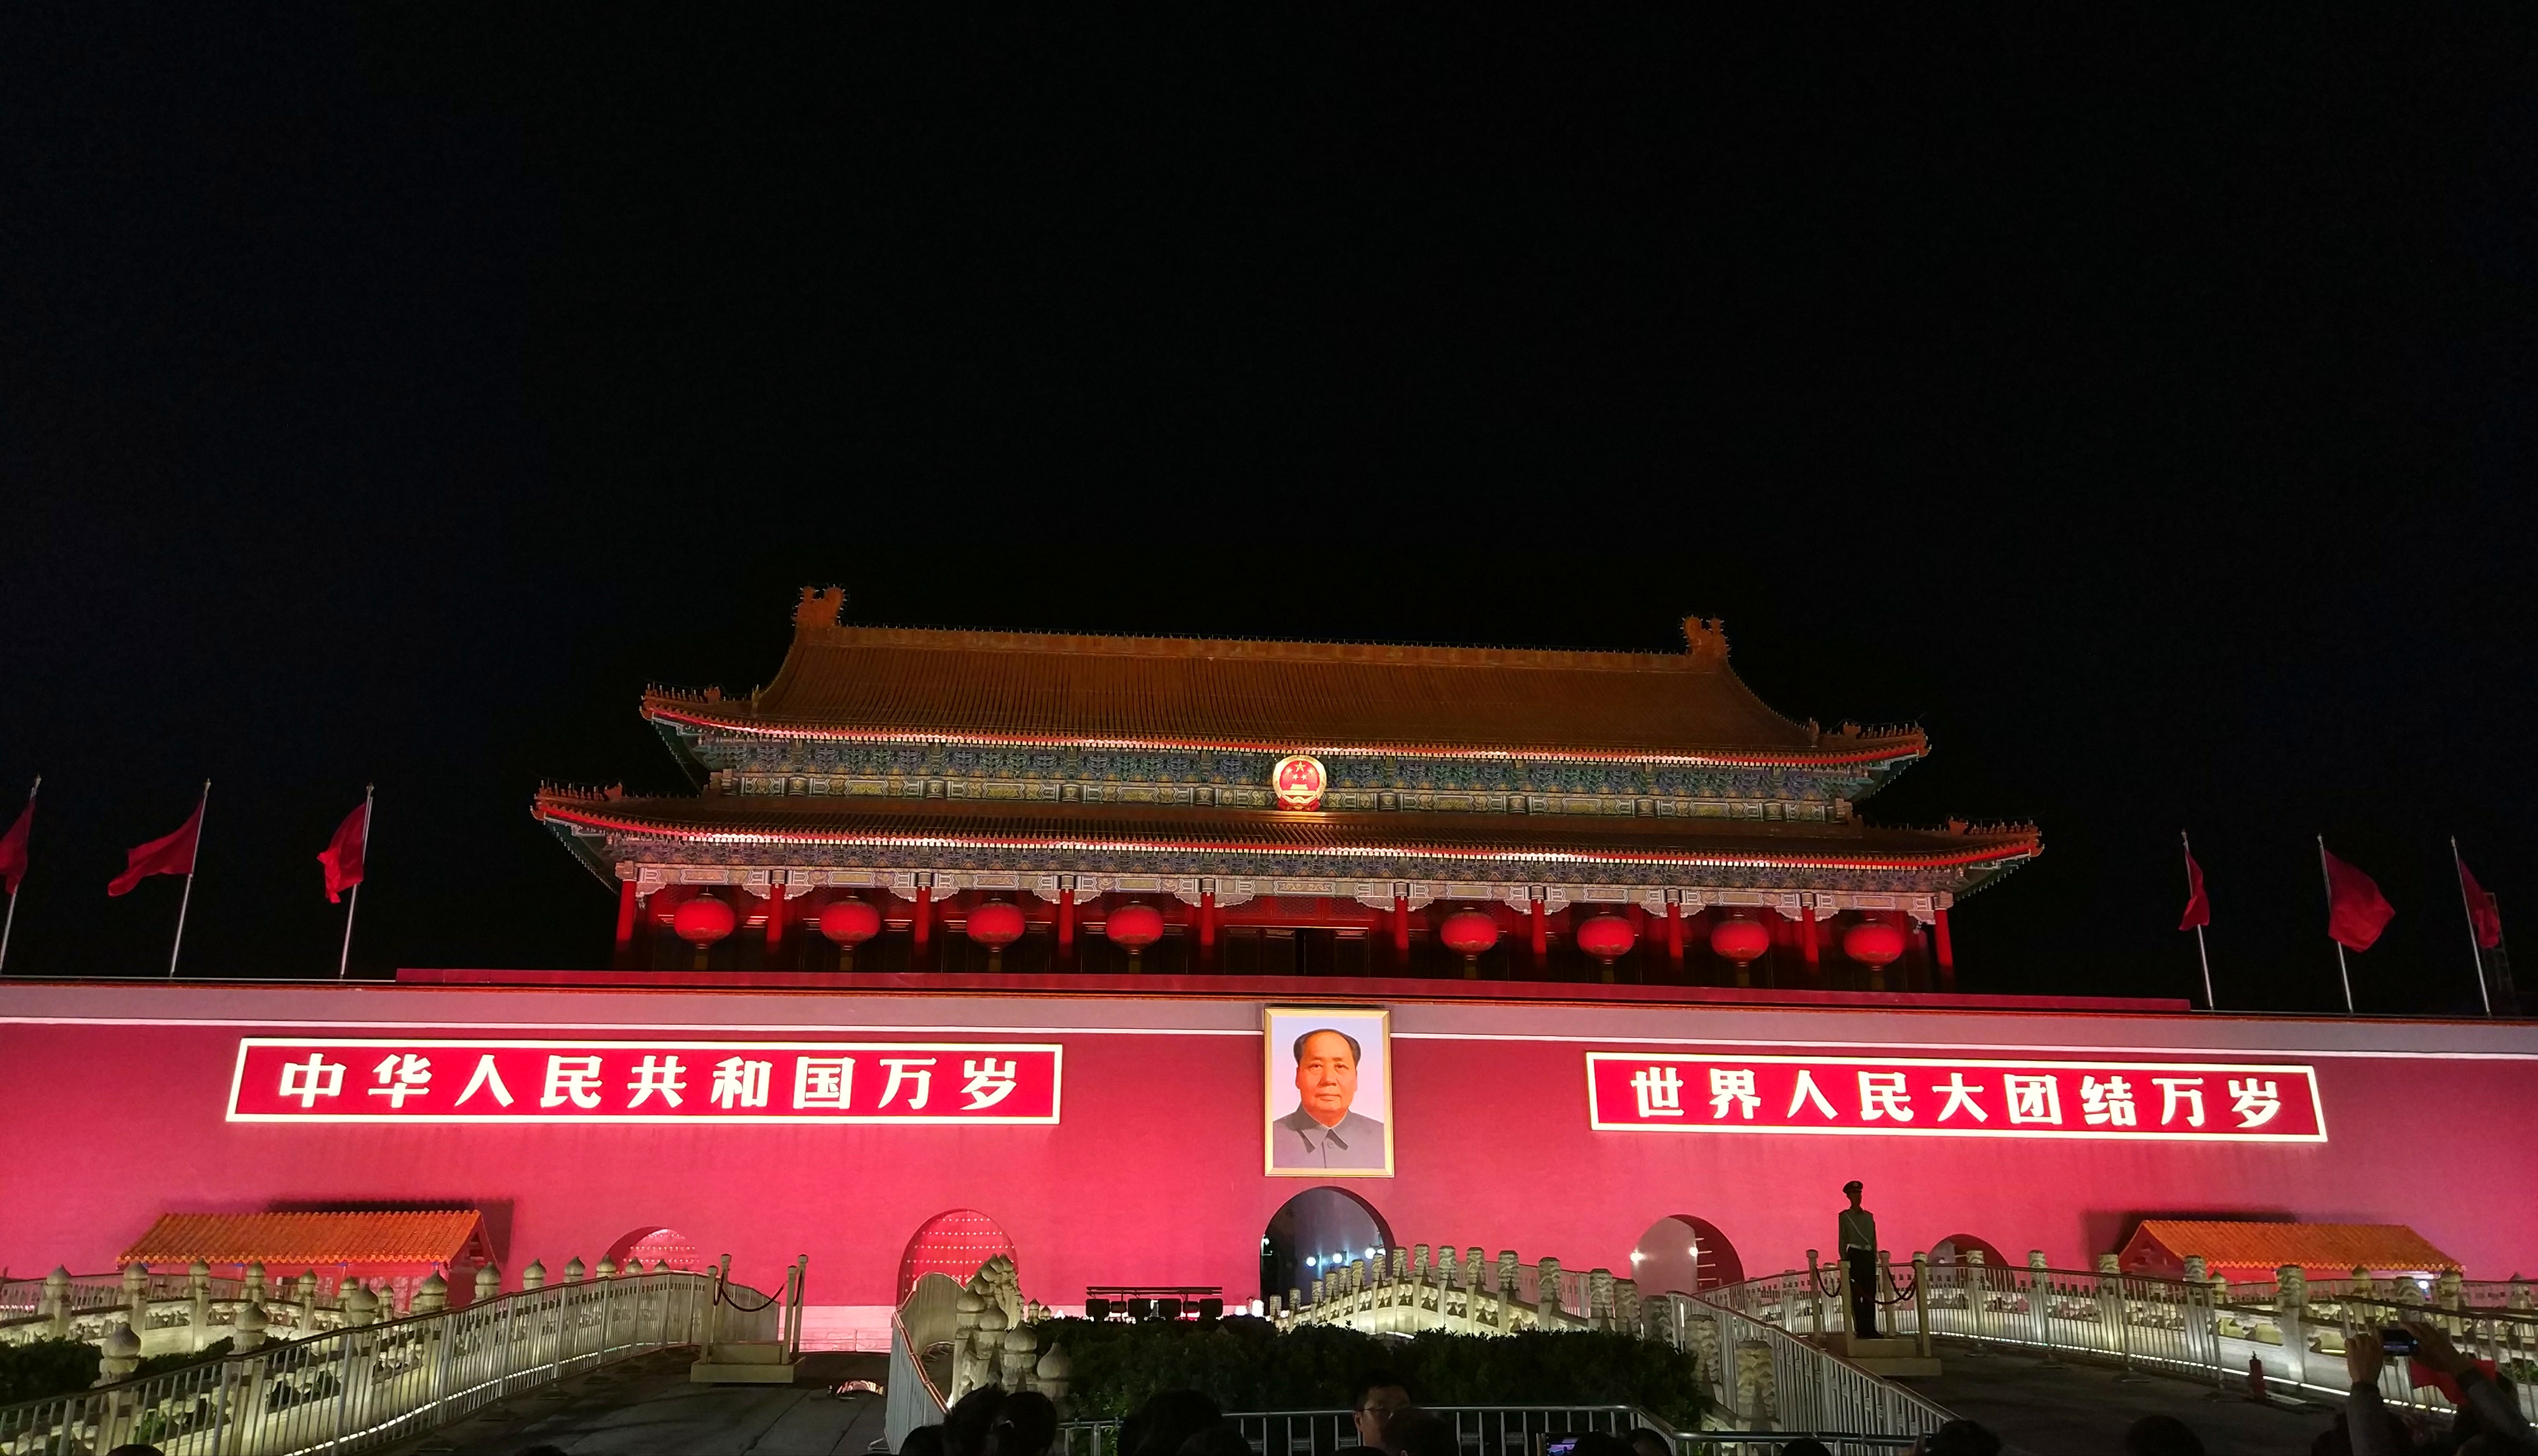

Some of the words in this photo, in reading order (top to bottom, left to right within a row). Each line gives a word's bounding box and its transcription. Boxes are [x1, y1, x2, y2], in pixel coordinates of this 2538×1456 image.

[279, 1053, 1018, 1110] 中华人民共和国万岁
[1630, 1066, 2282, 1128] 世界人民大团结万岁
